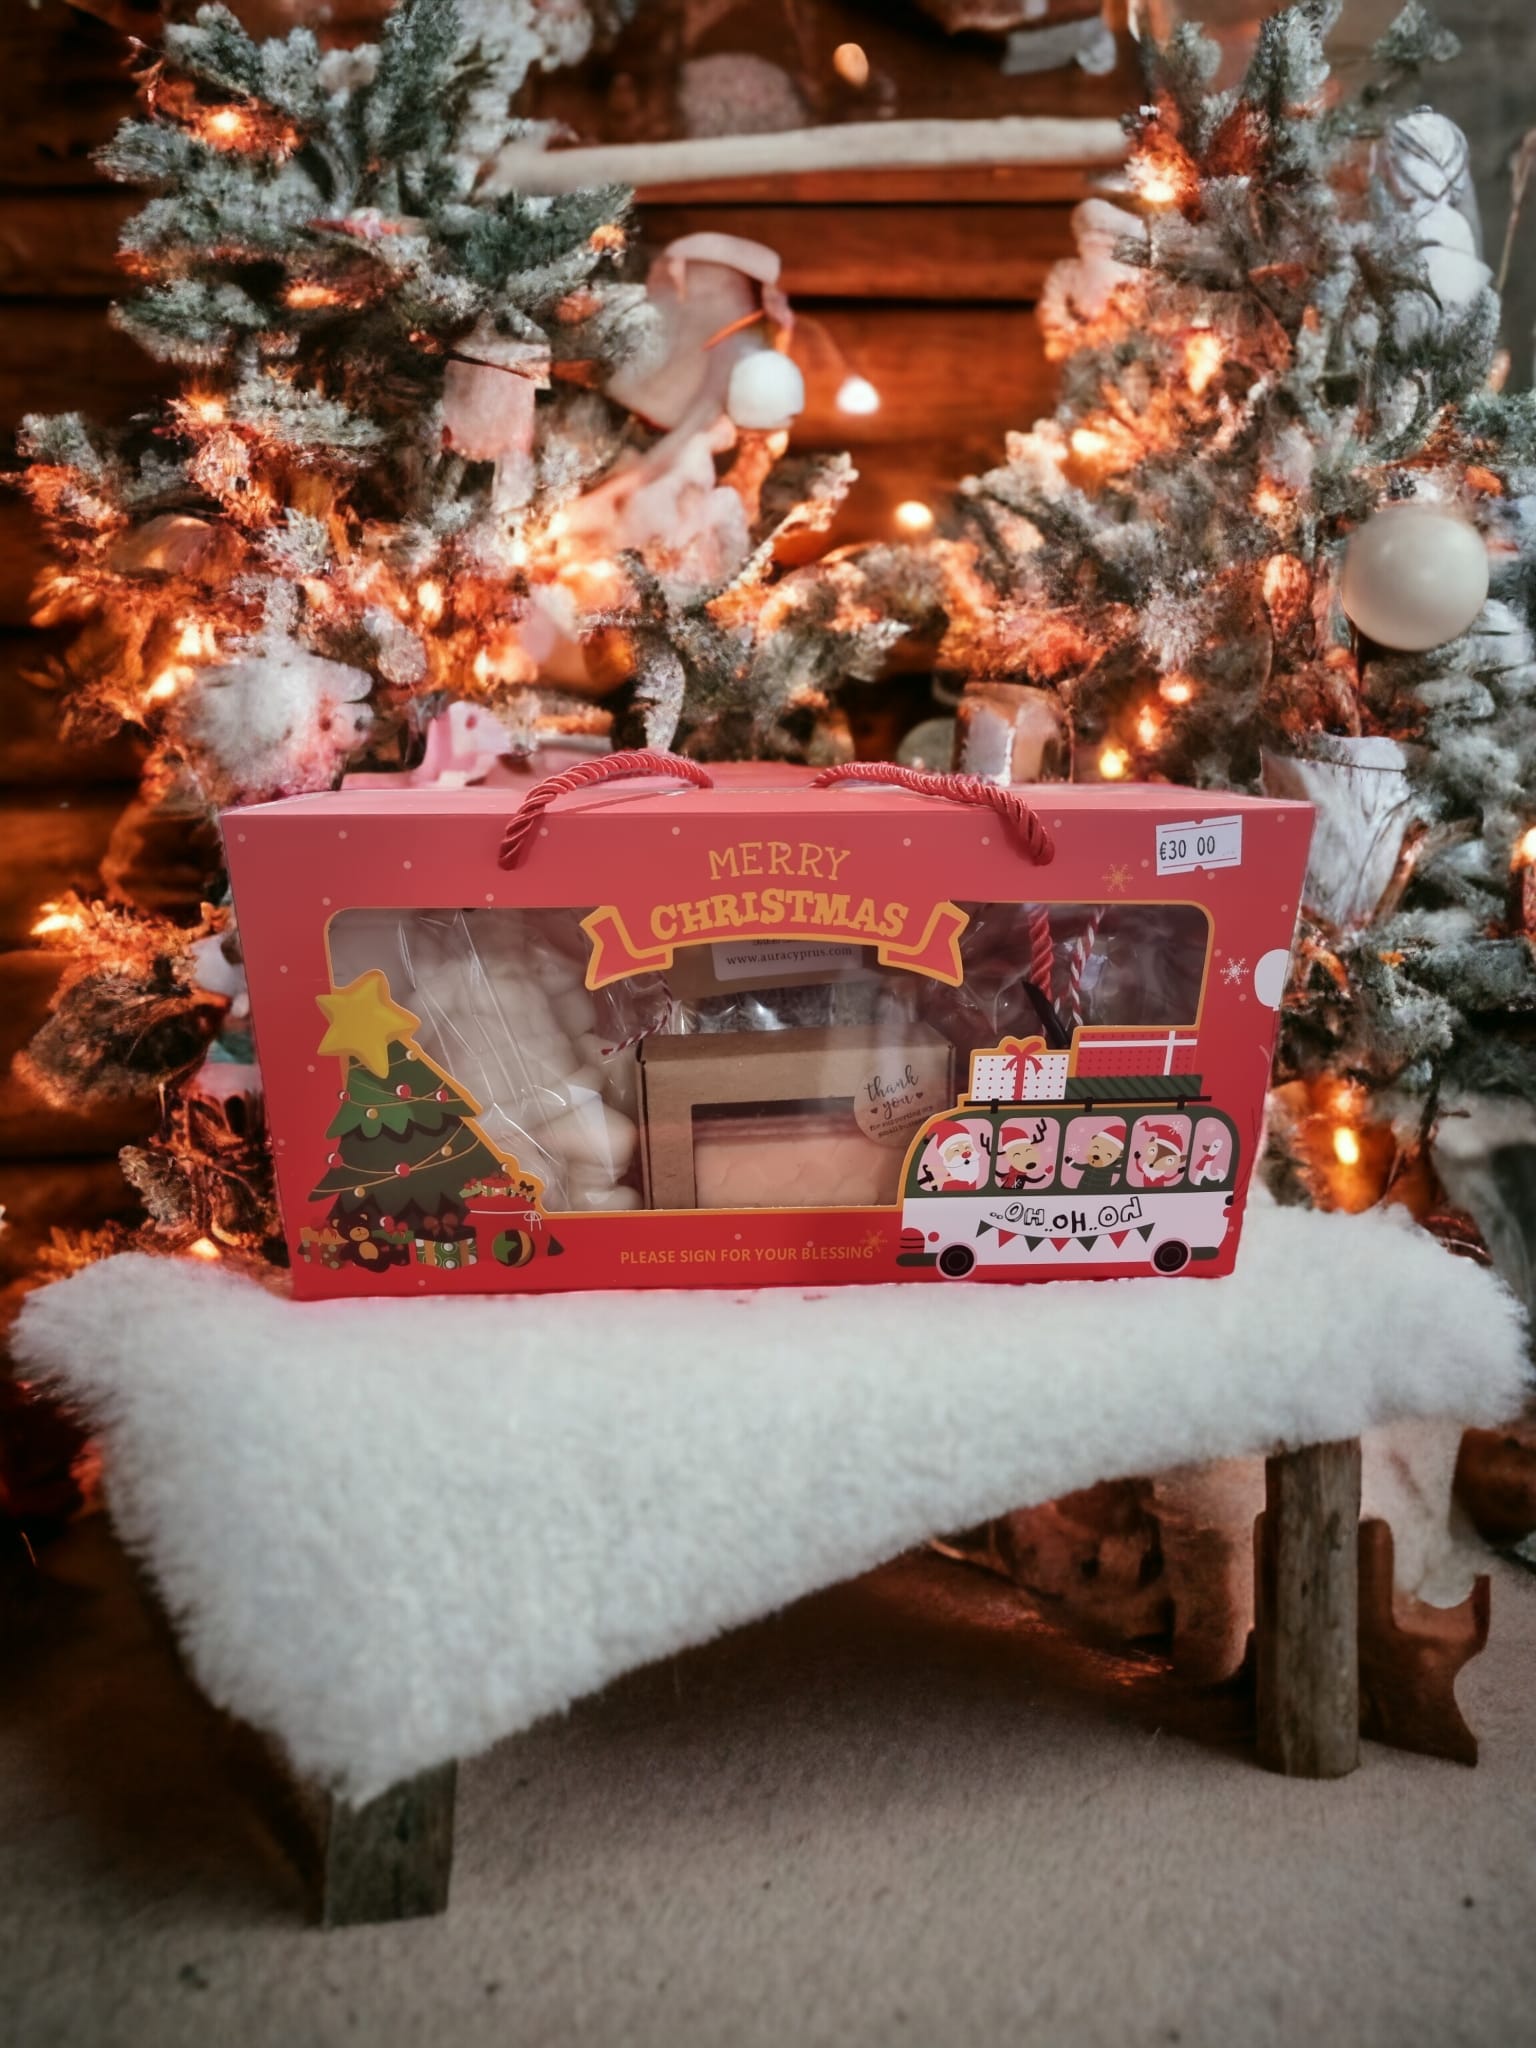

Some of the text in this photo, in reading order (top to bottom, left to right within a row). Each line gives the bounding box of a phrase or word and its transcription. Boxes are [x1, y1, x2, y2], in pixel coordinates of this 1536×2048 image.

[708, 841, 851, 881] MERRY
[1159, 835, 1216, 861] €30 00
[650, 888, 909, 940] CHRISTMAS
[726, 945, 852, 966] www.auracyprus.com
[863, 1063, 920, 1102] thank
[882, 1095, 914, 1120] you
[620, 1245, 874, 1265] PLEASE SIGN FOR YOUR BLESSING
